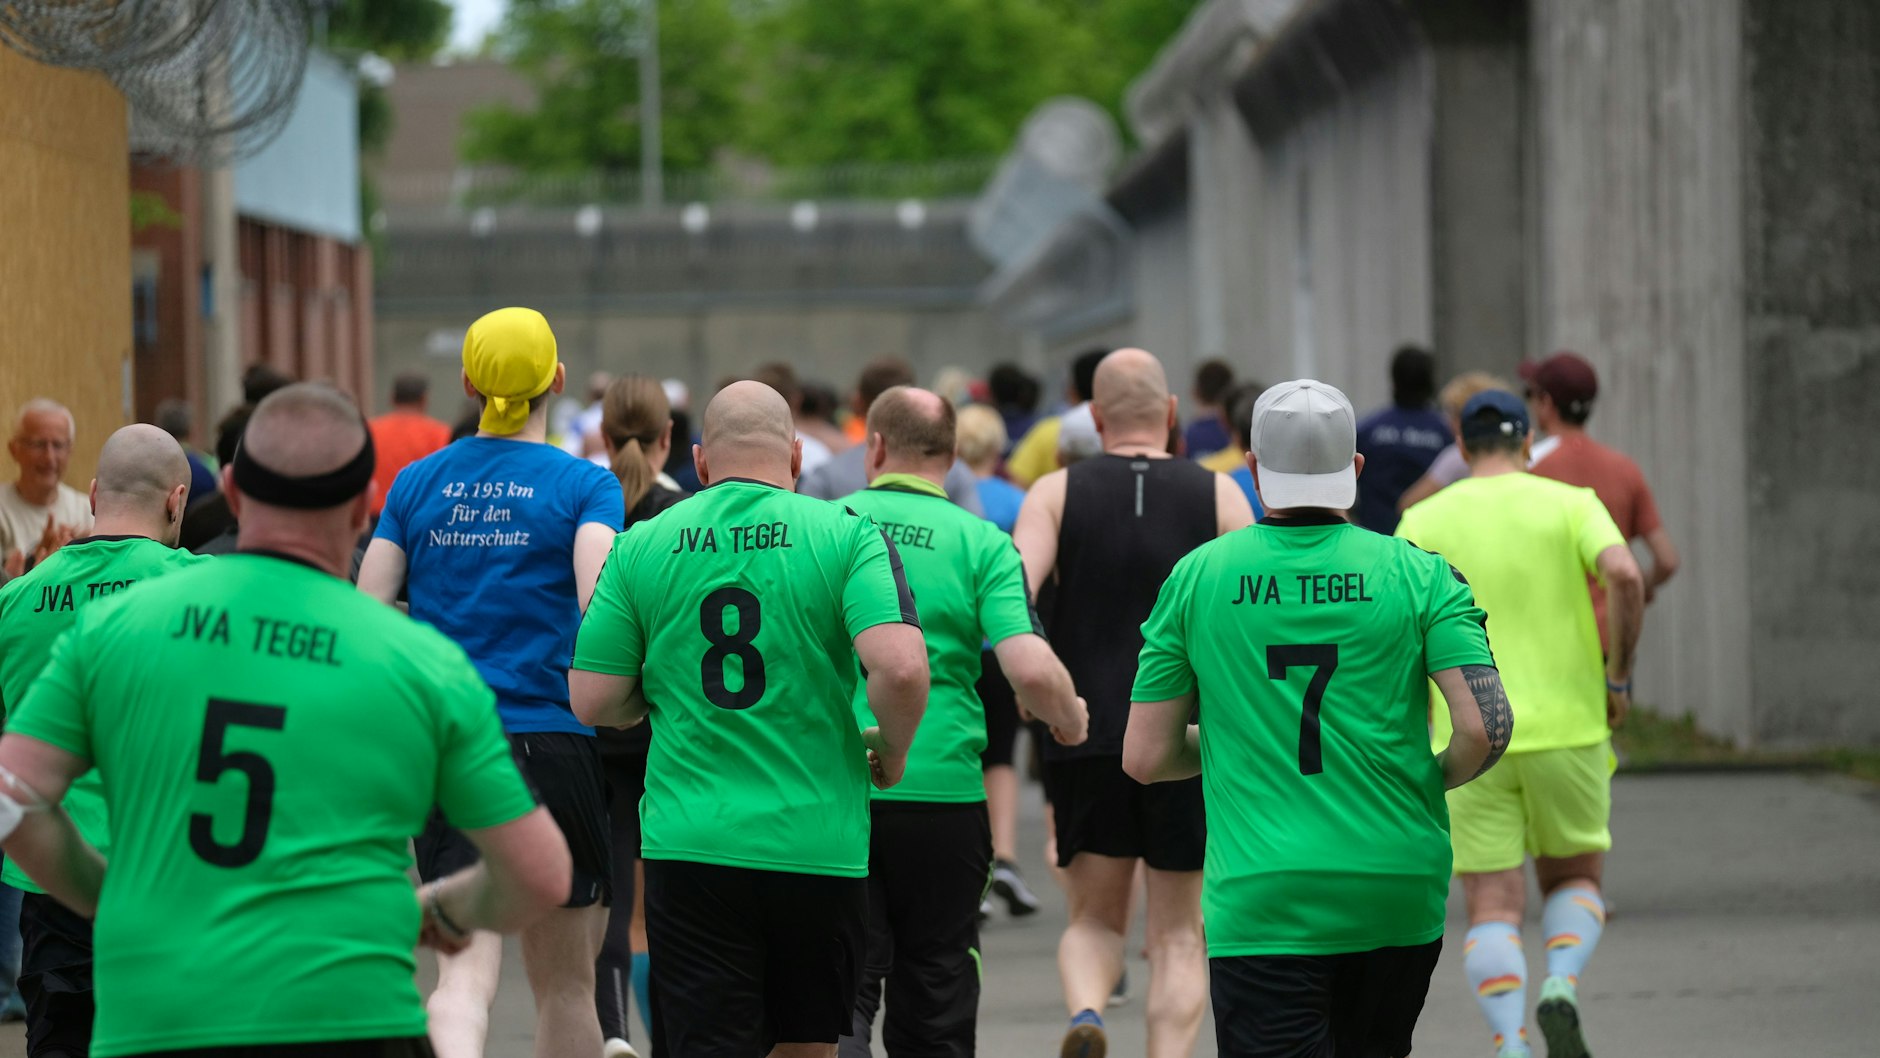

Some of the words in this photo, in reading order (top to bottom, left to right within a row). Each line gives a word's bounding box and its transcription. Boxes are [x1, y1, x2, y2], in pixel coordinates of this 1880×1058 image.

[507, 481, 534, 499] km
[447, 504, 480, 525] für
[483, 505, 512, 522] den
[429, 529, 530, 547] Naturschutz
[671, 527, 717, 554] JVA
[729, 522, 793, 553] TEGEL
[881, 522, 935, 550] TEGEL
[34, 585, 74, 612] JVA
[1231, 575, 1281, 605] JVA
[1296, 573, 1373, 604] TEGEL
[171, 605, 231, 647] JVA
[251, 615, 343, 667] TEGEL
[700, 587, 766, 710] 8
[1266, 644, 1338, 775] 7
[188, 696, 288, 868] 5
